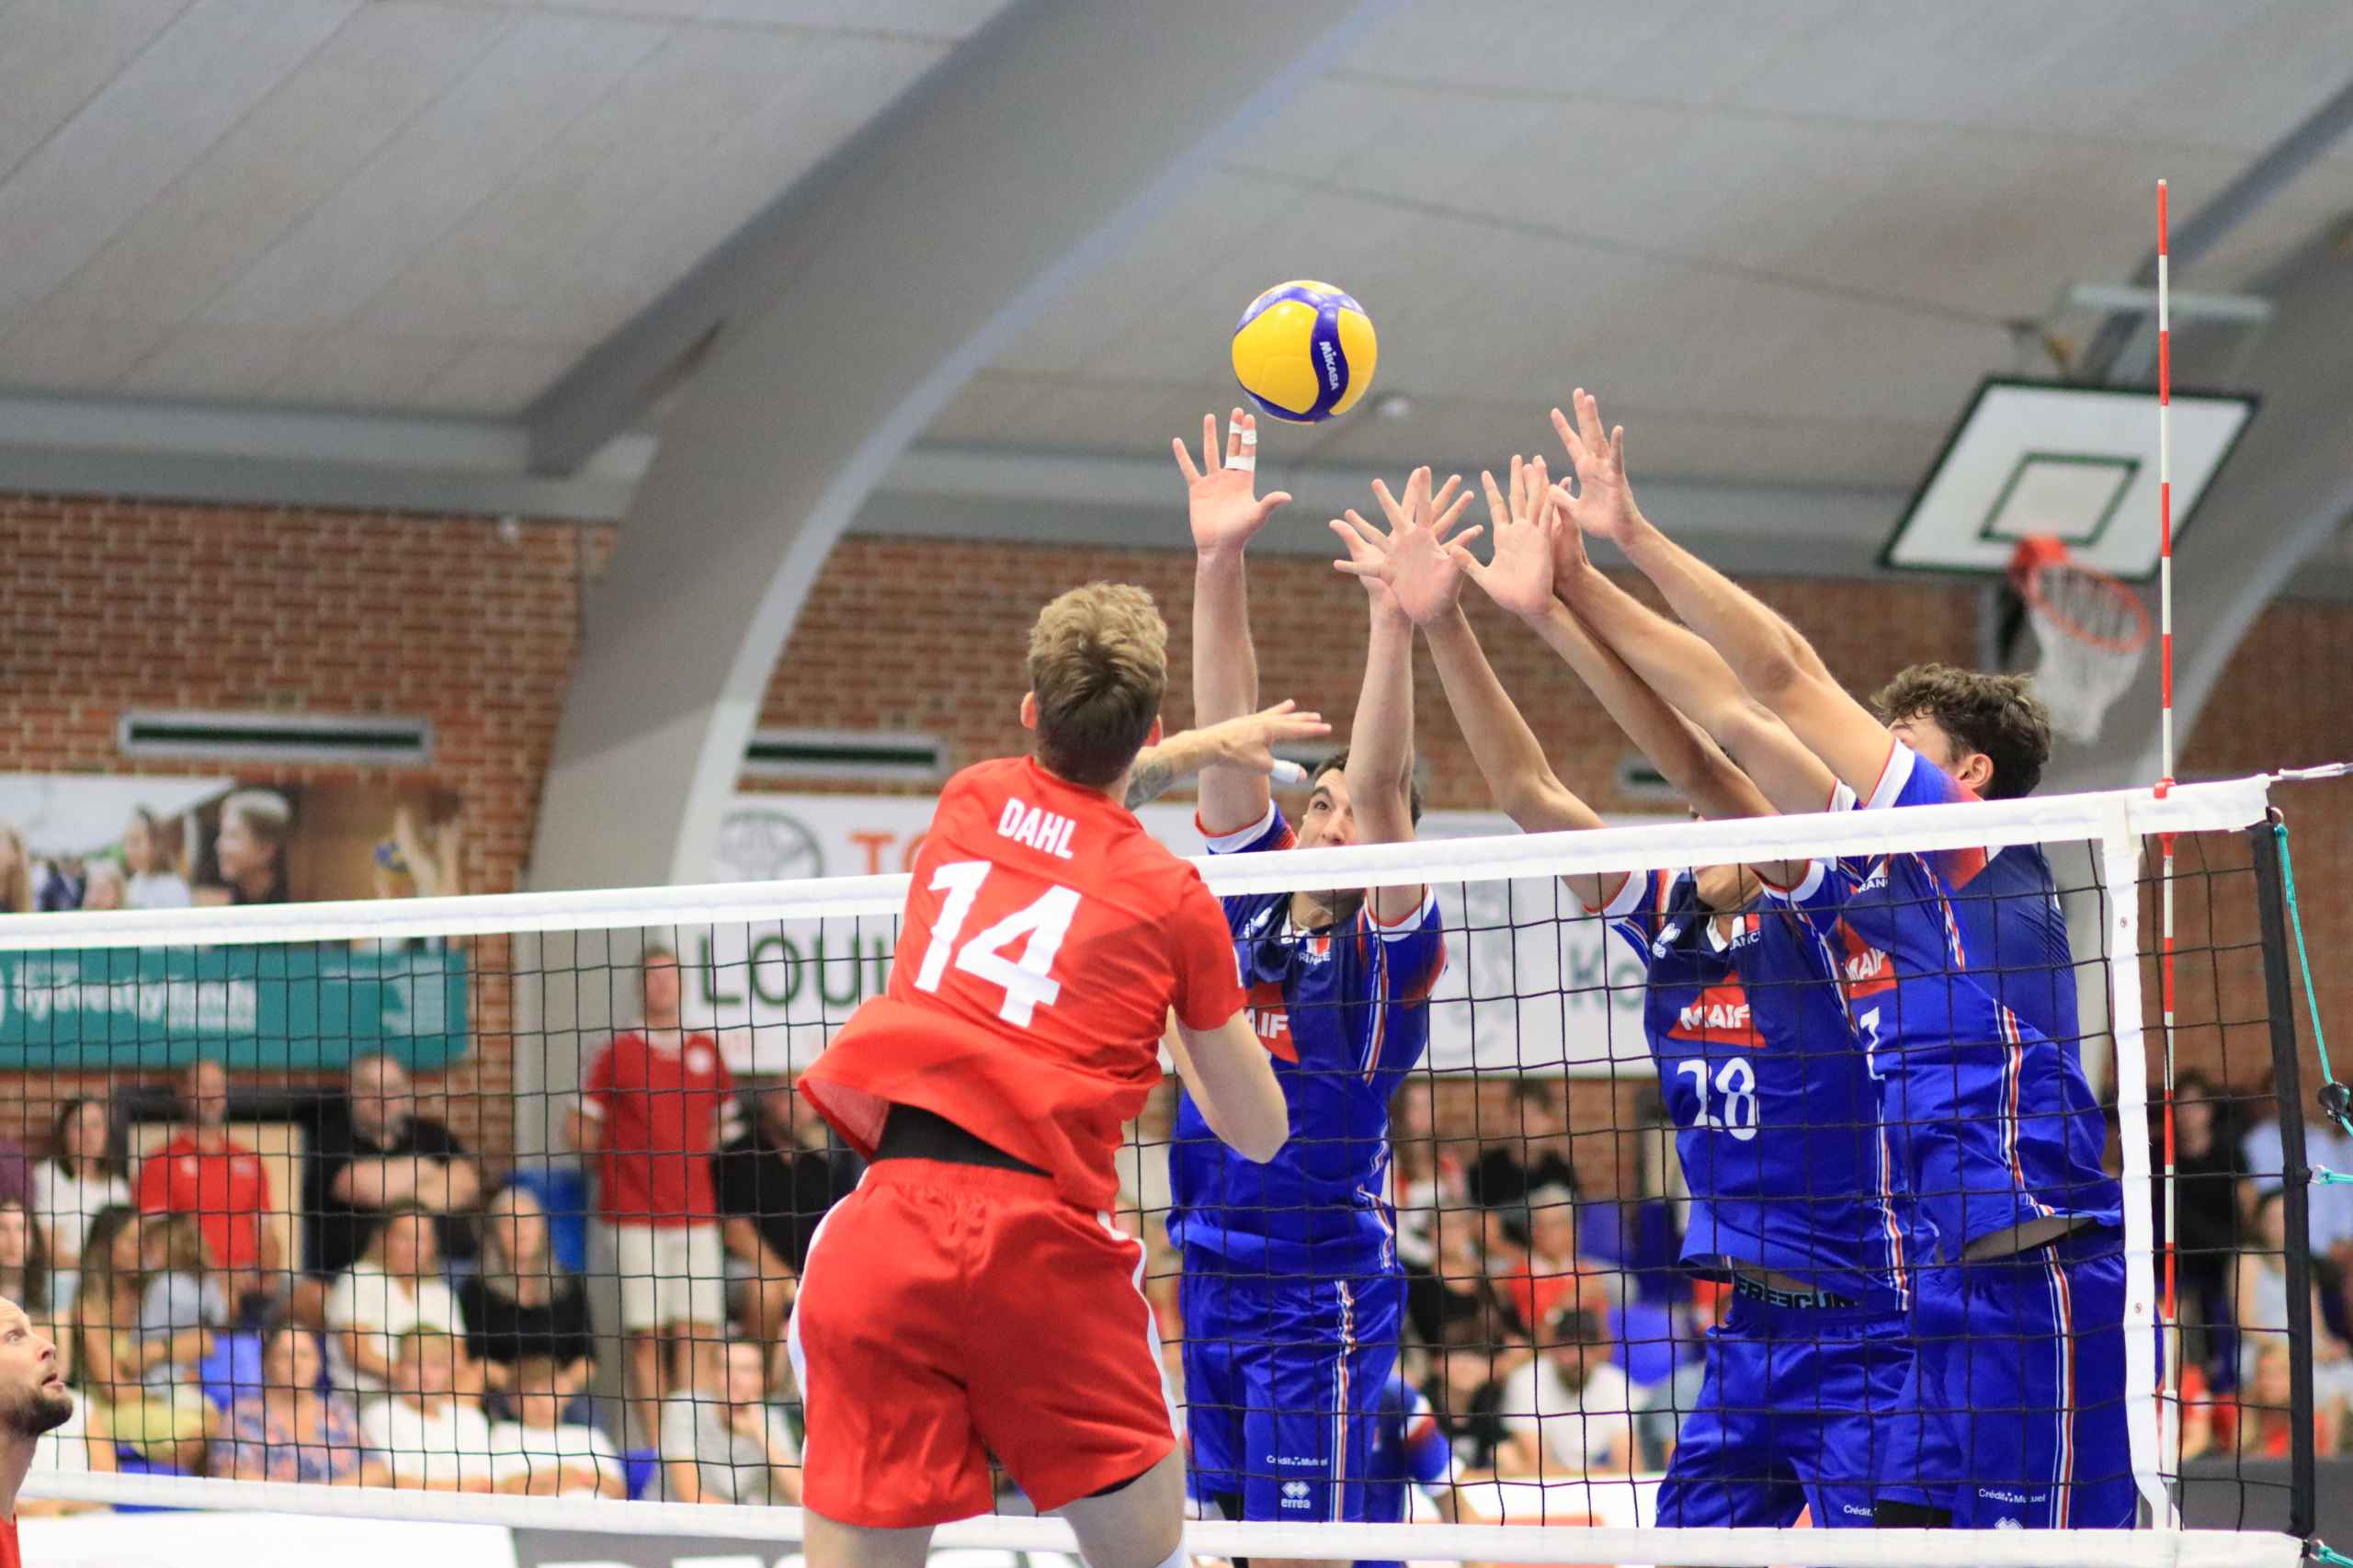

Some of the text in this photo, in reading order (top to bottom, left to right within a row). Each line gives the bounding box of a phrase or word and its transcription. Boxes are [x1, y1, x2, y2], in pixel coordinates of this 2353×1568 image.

[997, 797, 1076, 859] DAHL
[699, 933, 888, 1007] LOUI
[914, 860, 1082, 1028] 14
[1245, 1007, 1290, 1039] AIF
[1680, 1004, 1751, 1031] MAIF
[1677, 1057, 1761, 1142] 28
[2014, 1494, 2046, 1504] Muuel
